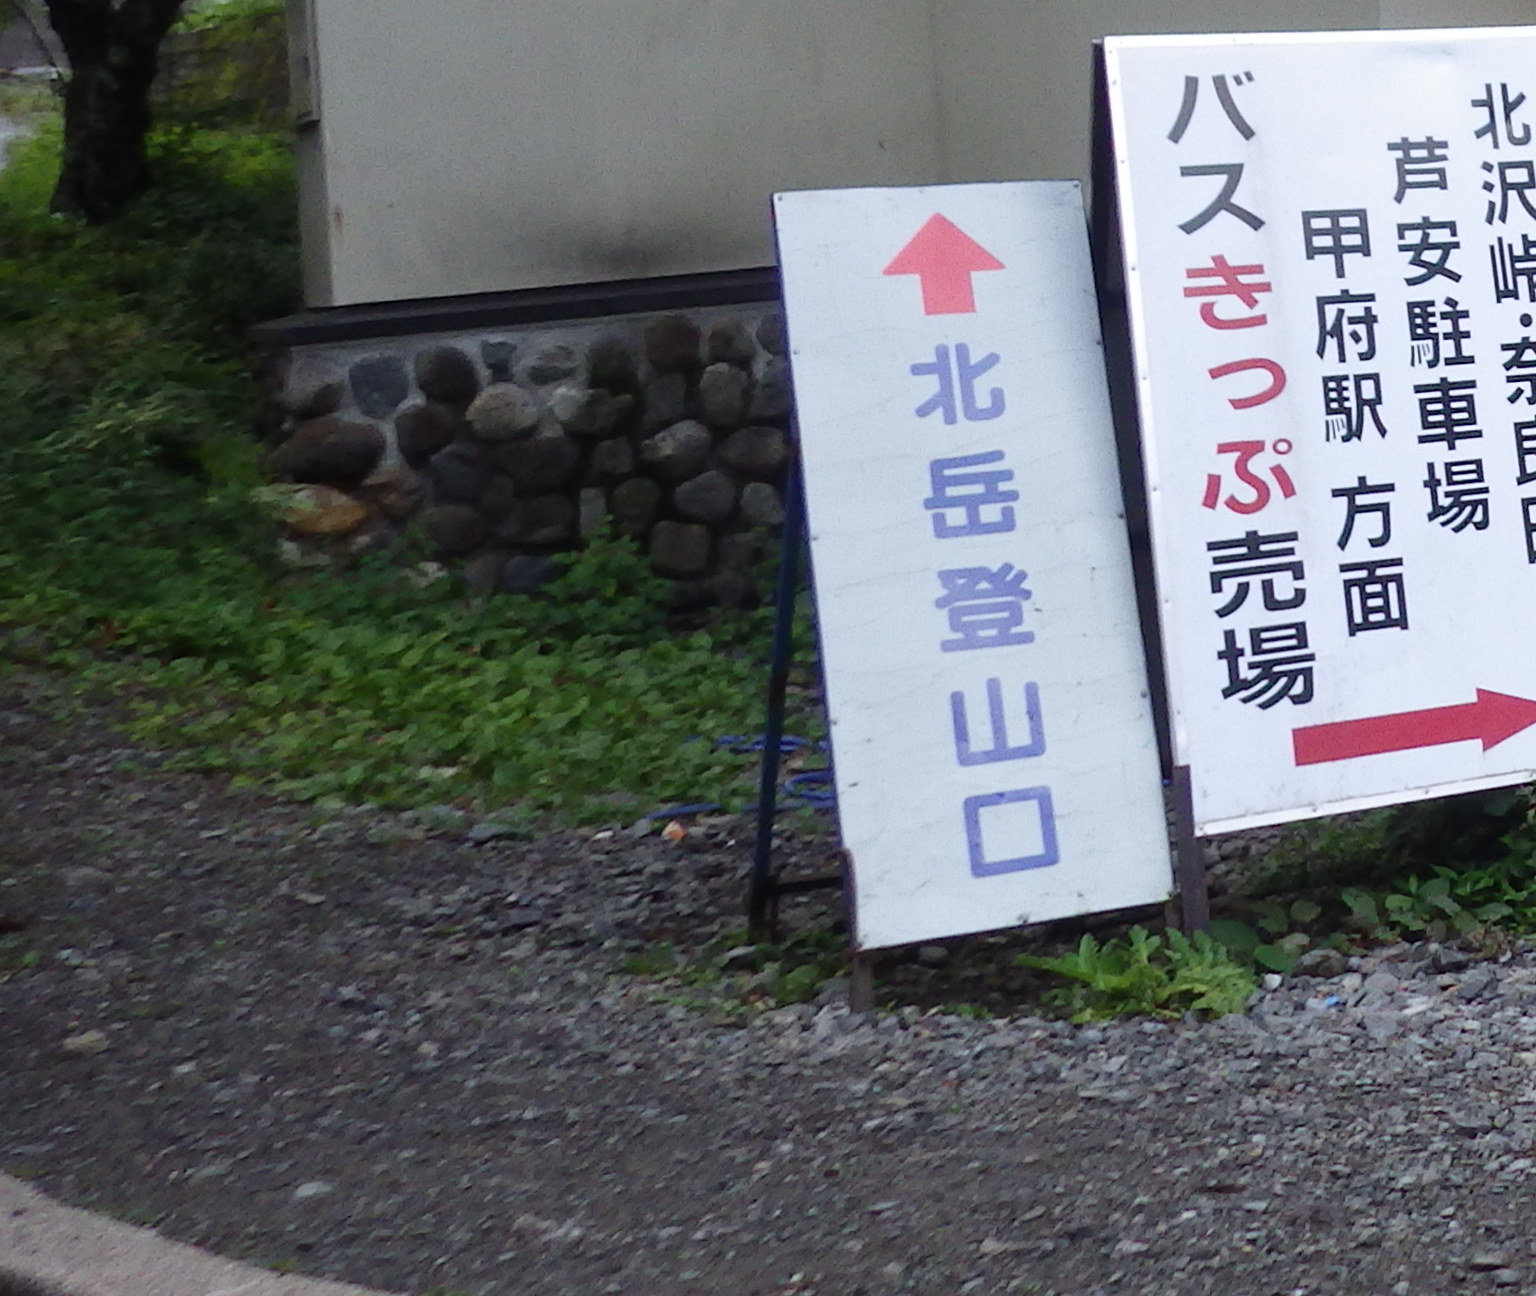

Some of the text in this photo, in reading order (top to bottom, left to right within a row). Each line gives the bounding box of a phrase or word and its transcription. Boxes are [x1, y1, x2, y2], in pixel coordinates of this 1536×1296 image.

[1166, 70, 1318, 711] バスきっぷ売場
[1387, 135, 1492, 535] 芦安駐車場
[909, 341, 1061, 878] 北岳登山口
